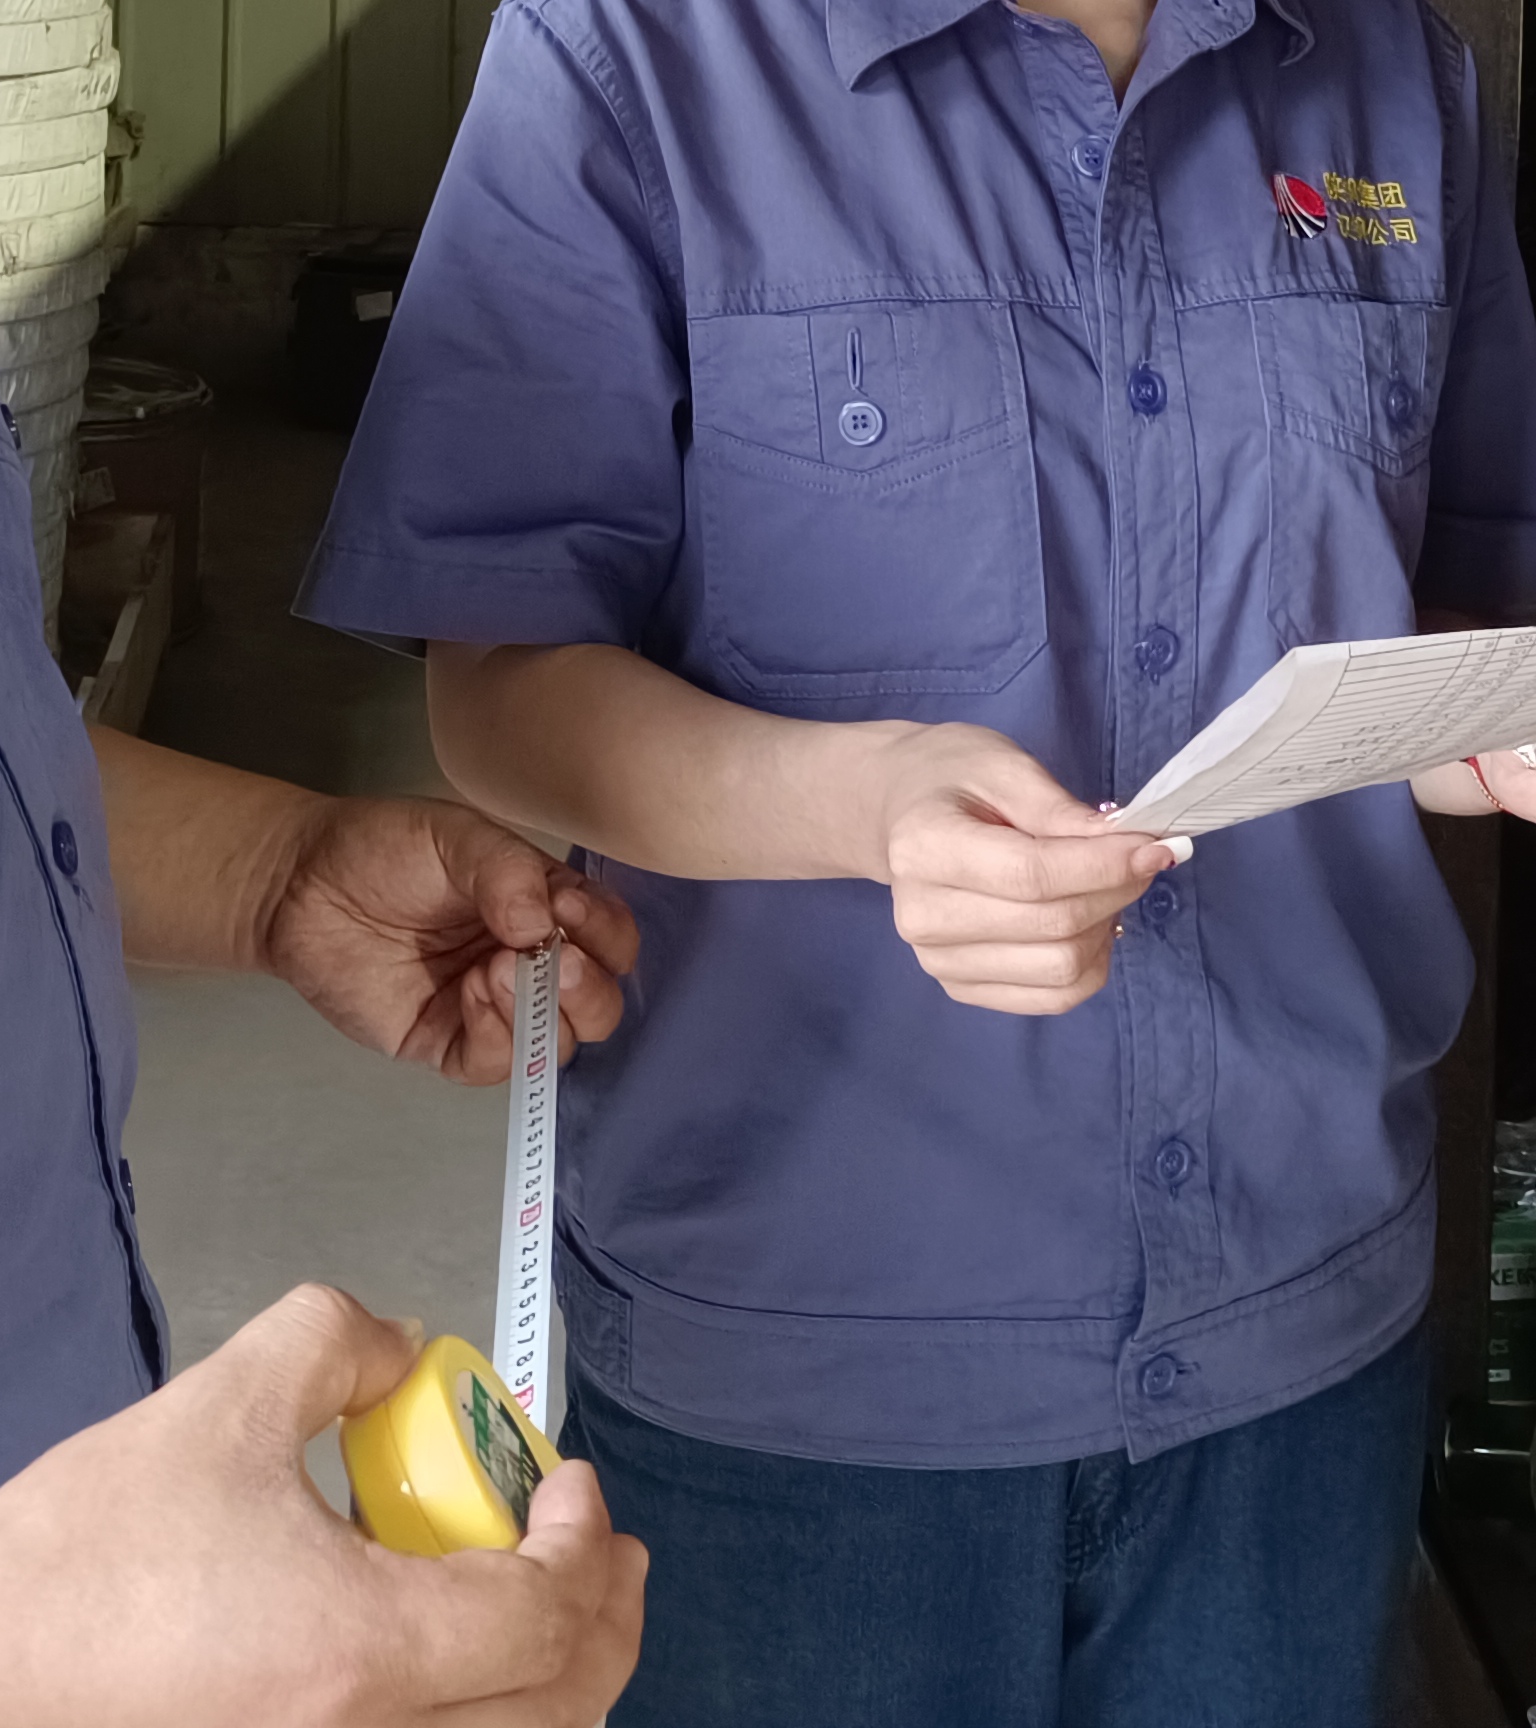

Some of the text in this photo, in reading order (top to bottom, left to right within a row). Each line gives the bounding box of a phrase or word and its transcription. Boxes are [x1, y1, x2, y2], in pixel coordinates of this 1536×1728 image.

[534, 972, 548, 983] 3
[533, 985, 548, 995] 4
[533, 995, 548, 1008] 5
[532, 1008, 547, 1020] 6
[532, 1020, 547, 1031] 7
[532, 1033, 546, 1045] 8
[531, 1046, 546, 1058] 9
[530, 1074, 544, 1084] 1
[529, 1087, 544, 1100] 2
[529, 1101, 544, 1114] 3
[528, 1116, 543, 1127] 4
[527, 1129, 543, 1143] 5
[526, 1144, 542, 1158] 6
[526, 1158, 542, 1171] 7
[525, 1175, 542, 1189] 8
[525, 1191, 541, 1205] 9
[523, 1224, 539, 1236] 1
[522, 1240, 538, 1256] 2
[521, 1258, 538, 1273] 3
[521, 1276, 538, 1290] 4
[519, 1292, 537, 1309] 5
[518, 1312, 536, 1328] 6
[518, 1330, 535, 1344] 7
[516, 1350, 534, 1367] 8
[515, 1371, 533, 1387] 9
